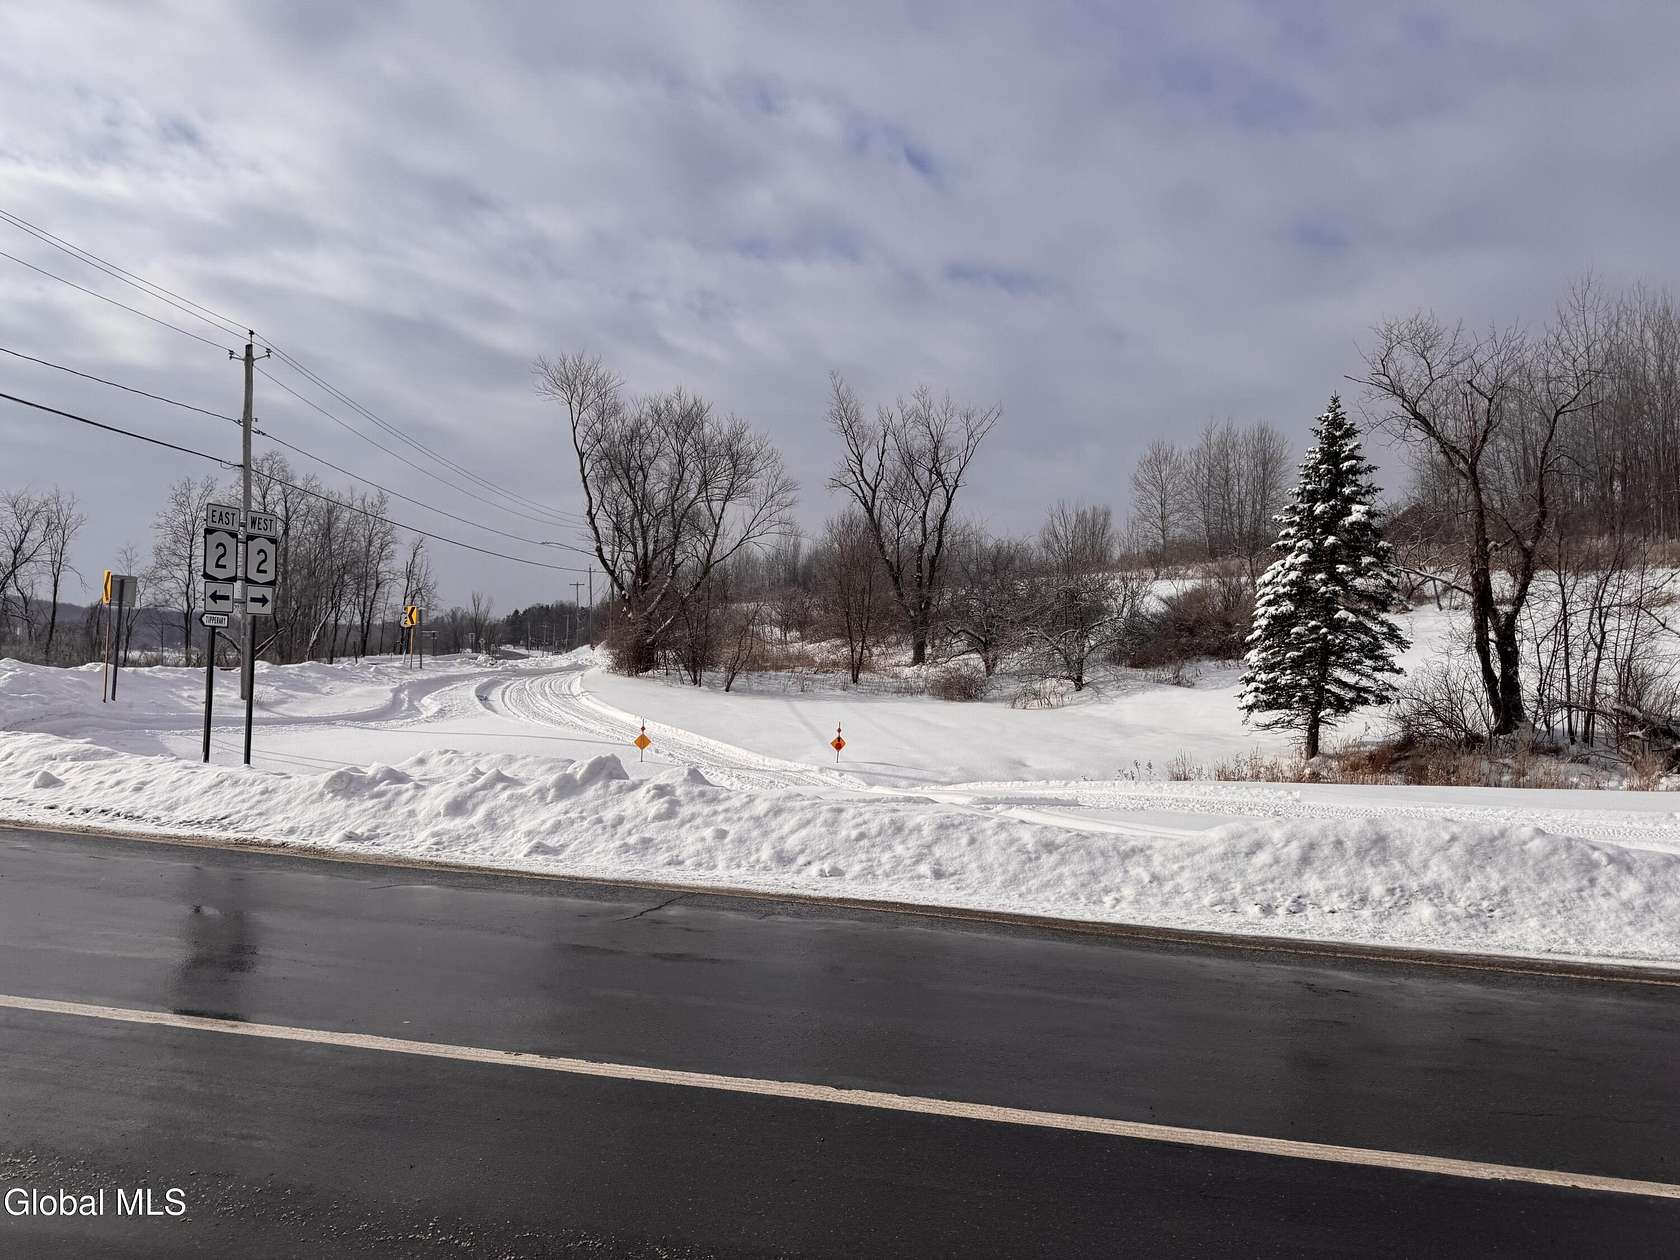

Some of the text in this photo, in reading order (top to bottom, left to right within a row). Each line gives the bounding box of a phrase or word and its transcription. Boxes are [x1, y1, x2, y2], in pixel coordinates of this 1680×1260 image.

[211, 509, 236, 526] EAST
[250, 515, 274, 532] WEST
[215, 542, 227, 569] 2
[256, 548, 268, 574] 2
[205, 615, 226, 625] TIPPERARY
